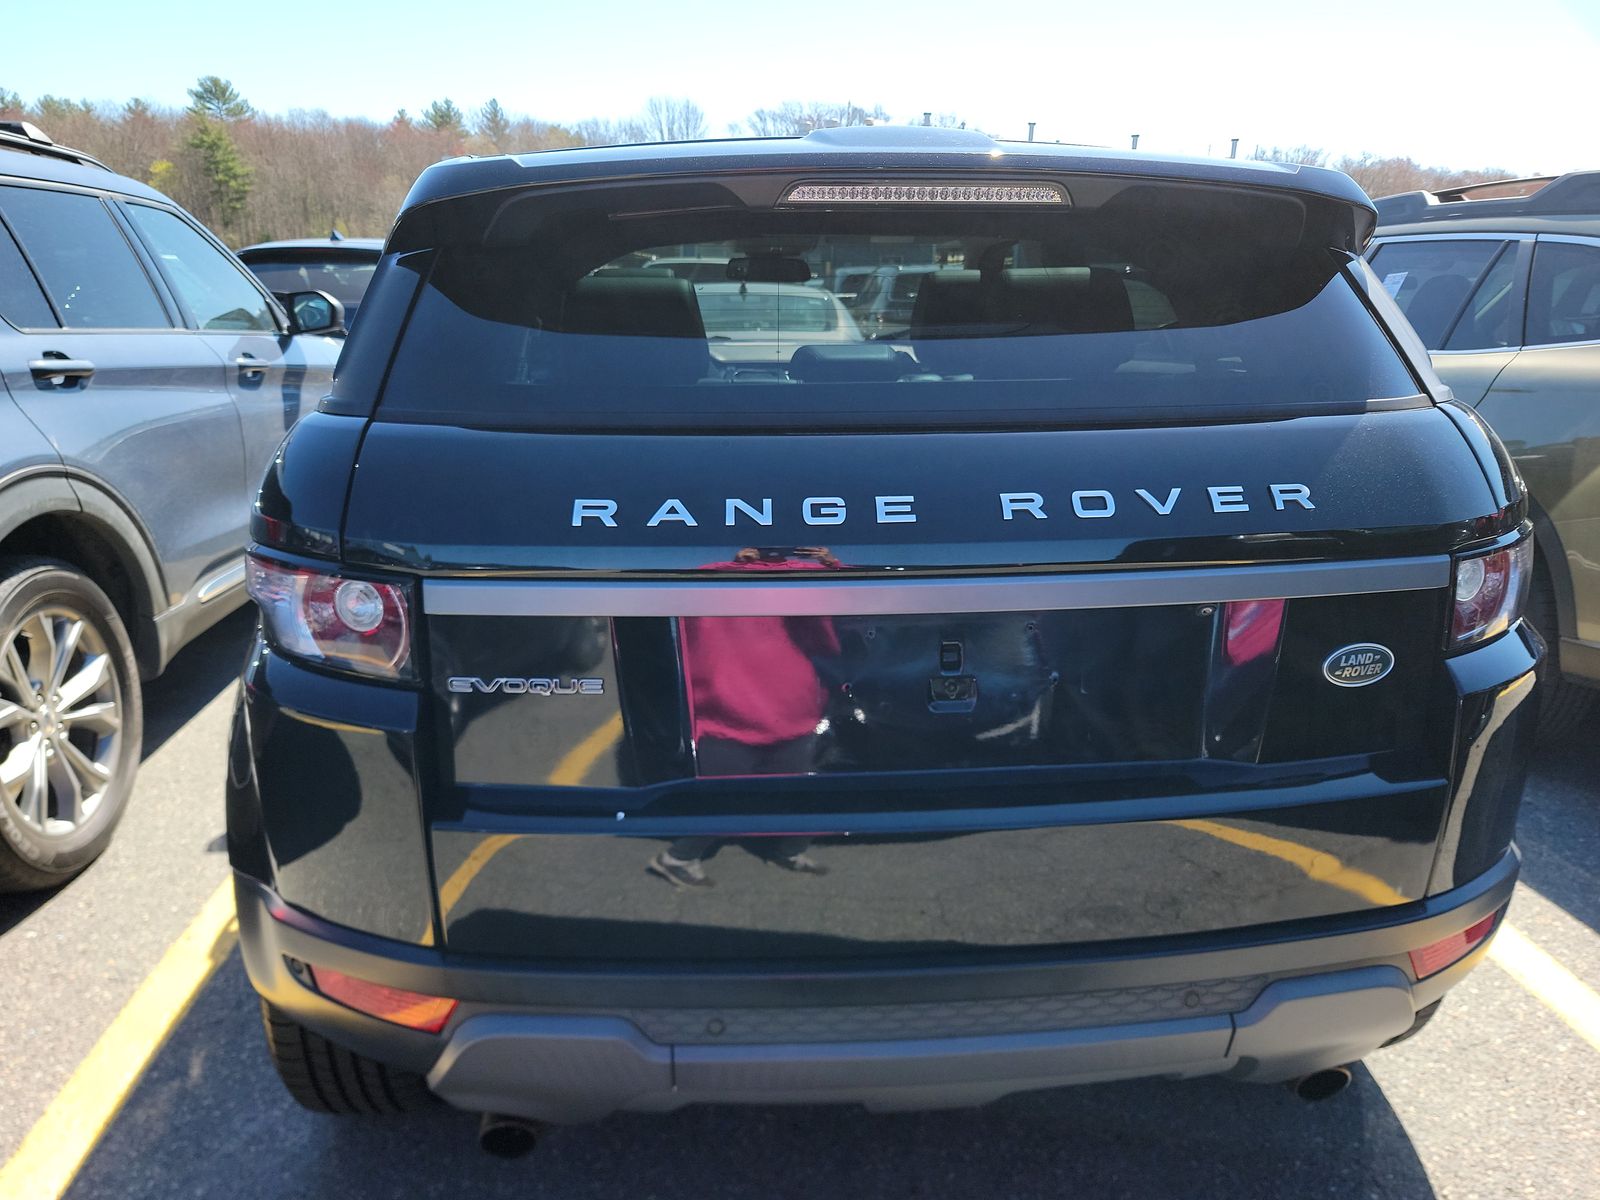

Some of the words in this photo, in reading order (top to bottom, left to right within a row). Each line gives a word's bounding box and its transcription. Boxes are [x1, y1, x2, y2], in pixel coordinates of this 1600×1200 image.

[571, 495, 917, 527] RANGE
[999, 483, 1316, 520] ROVER
[448, 677, 604, 696] EVOQUE
